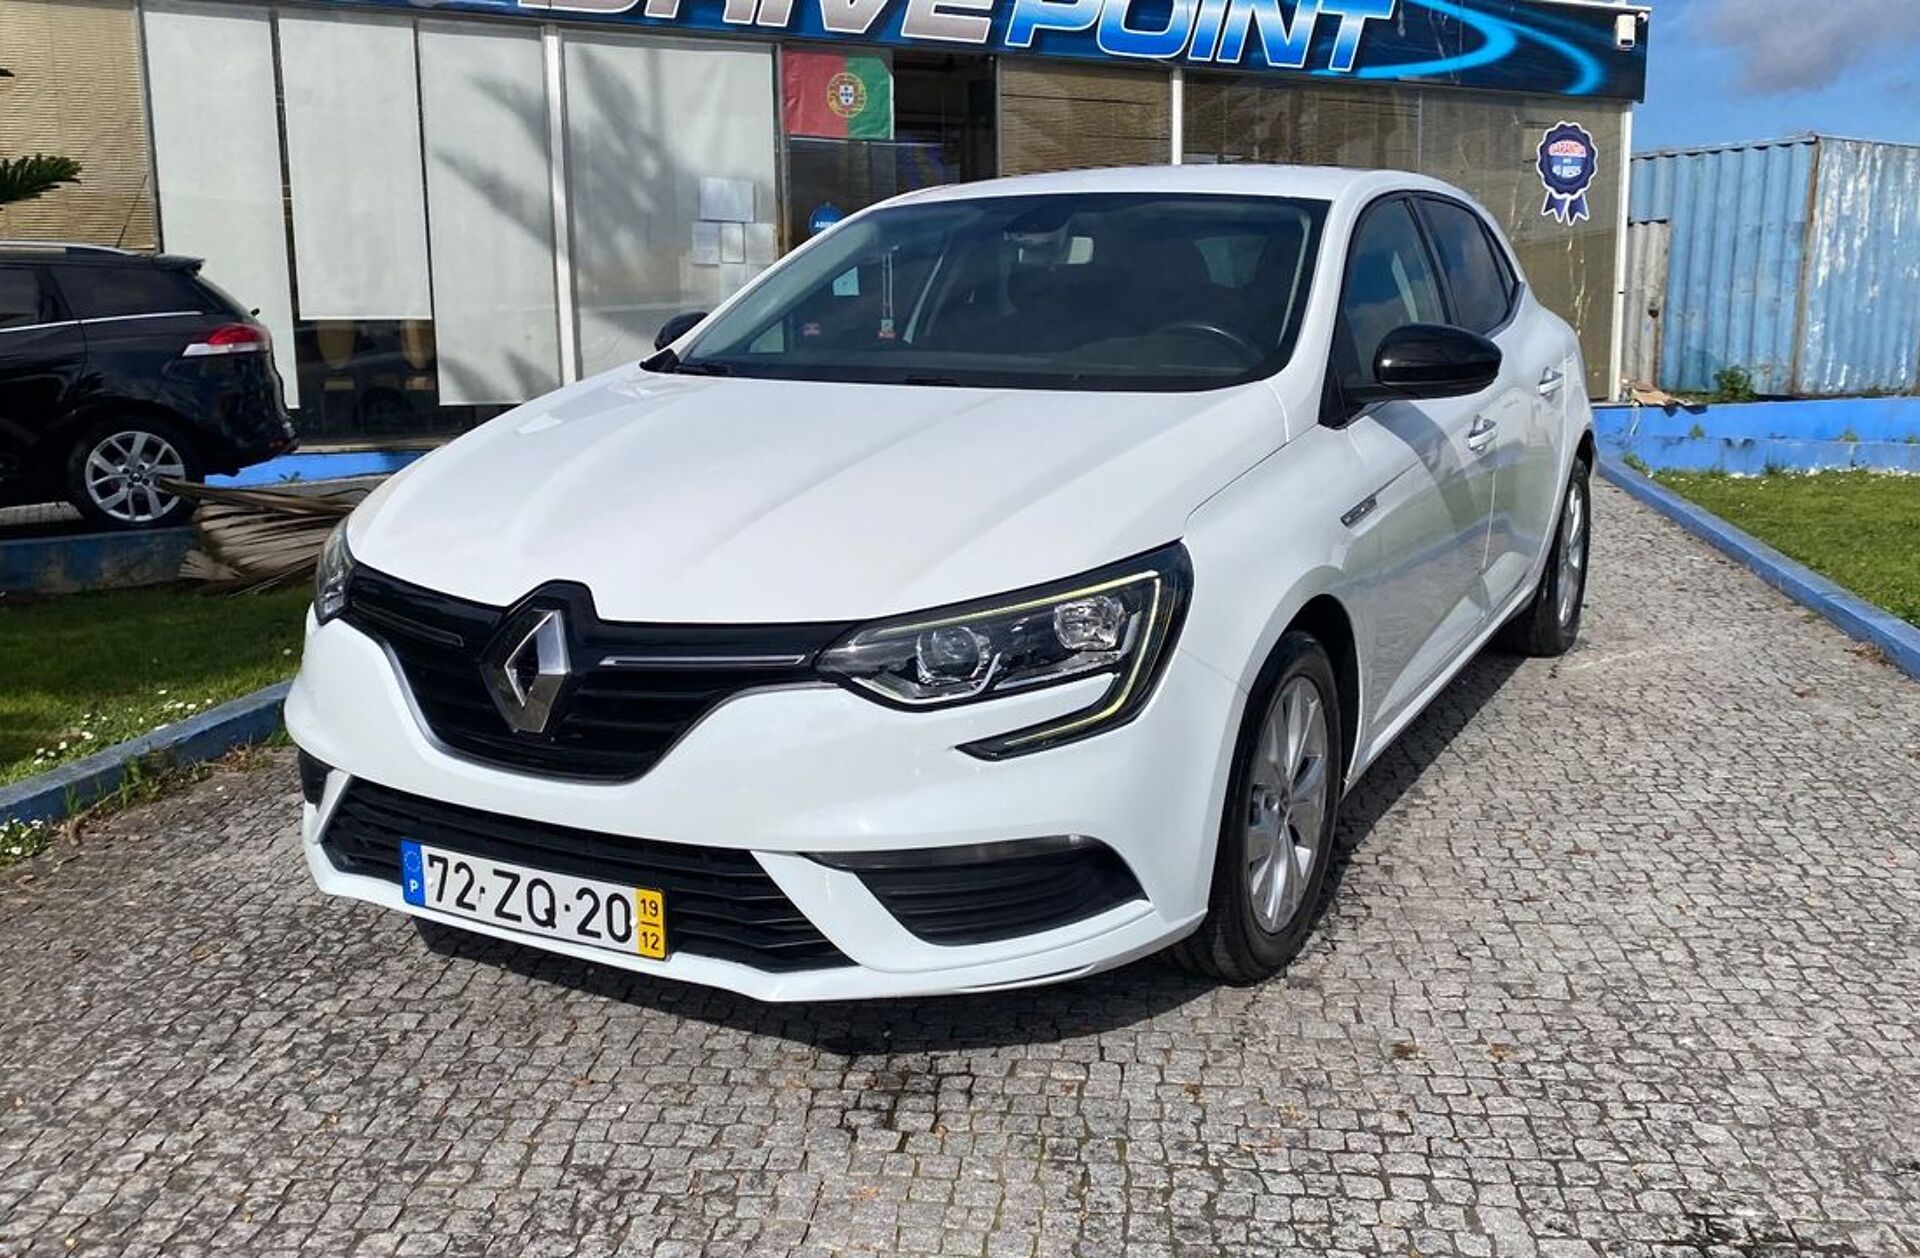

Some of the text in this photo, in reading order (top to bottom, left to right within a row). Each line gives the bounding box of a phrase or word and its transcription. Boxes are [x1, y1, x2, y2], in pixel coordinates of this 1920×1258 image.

[410, 880, 420, 893] P
[640, 899, 660, 918] 19
[641, 931, 660, 951] 12
